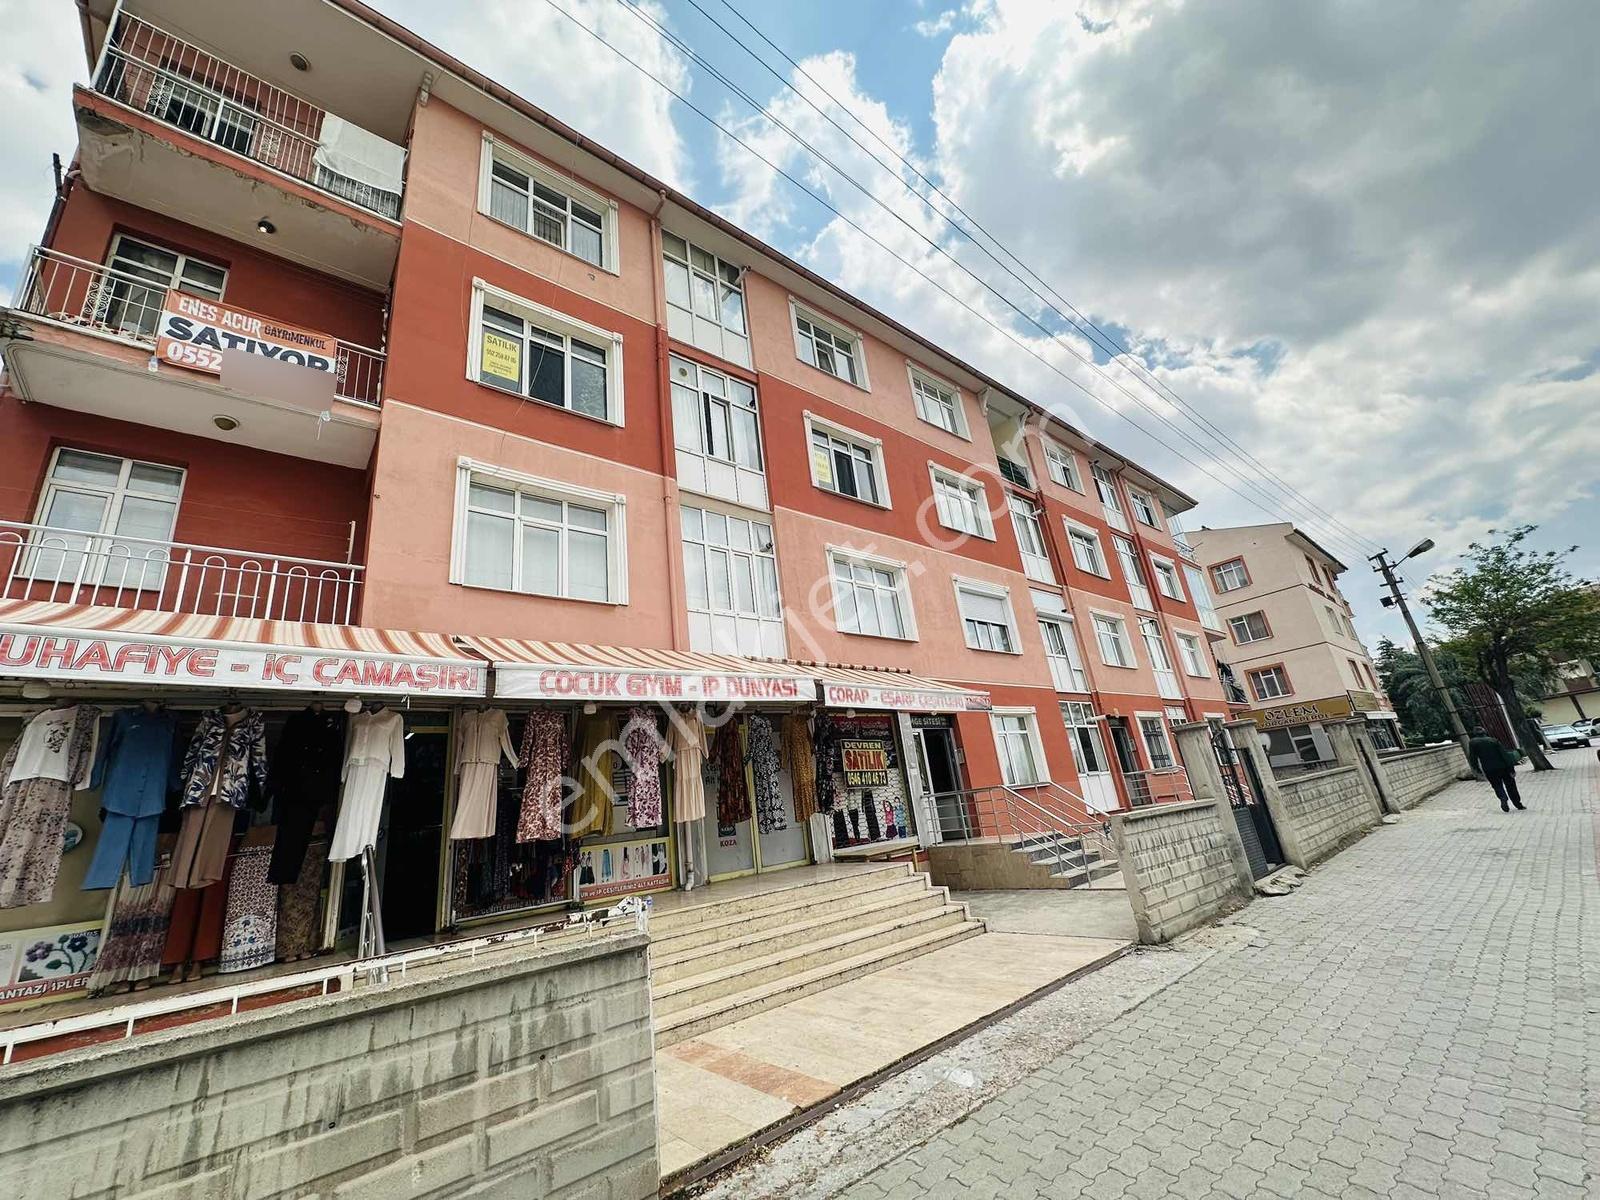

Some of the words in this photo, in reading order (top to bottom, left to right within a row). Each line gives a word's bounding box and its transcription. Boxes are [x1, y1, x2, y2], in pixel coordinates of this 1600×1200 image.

[178, 297, 218, 322] ENES
[221, 310, 262, 339] ACUR
[486, 335, 517, 353] SATILIK
[166, 341, 222, 370] 0552
[262, 654, 302, 685] İÇ
[312, 657, 479, 691] ÇAMAŞIRI
[828, 686, 869, 705] ÇORAP
[844, 741, 881, 749] DEVREN
[844, 749, 885, 771] SATILIK
[720, 839, 737, 847] KOZA
